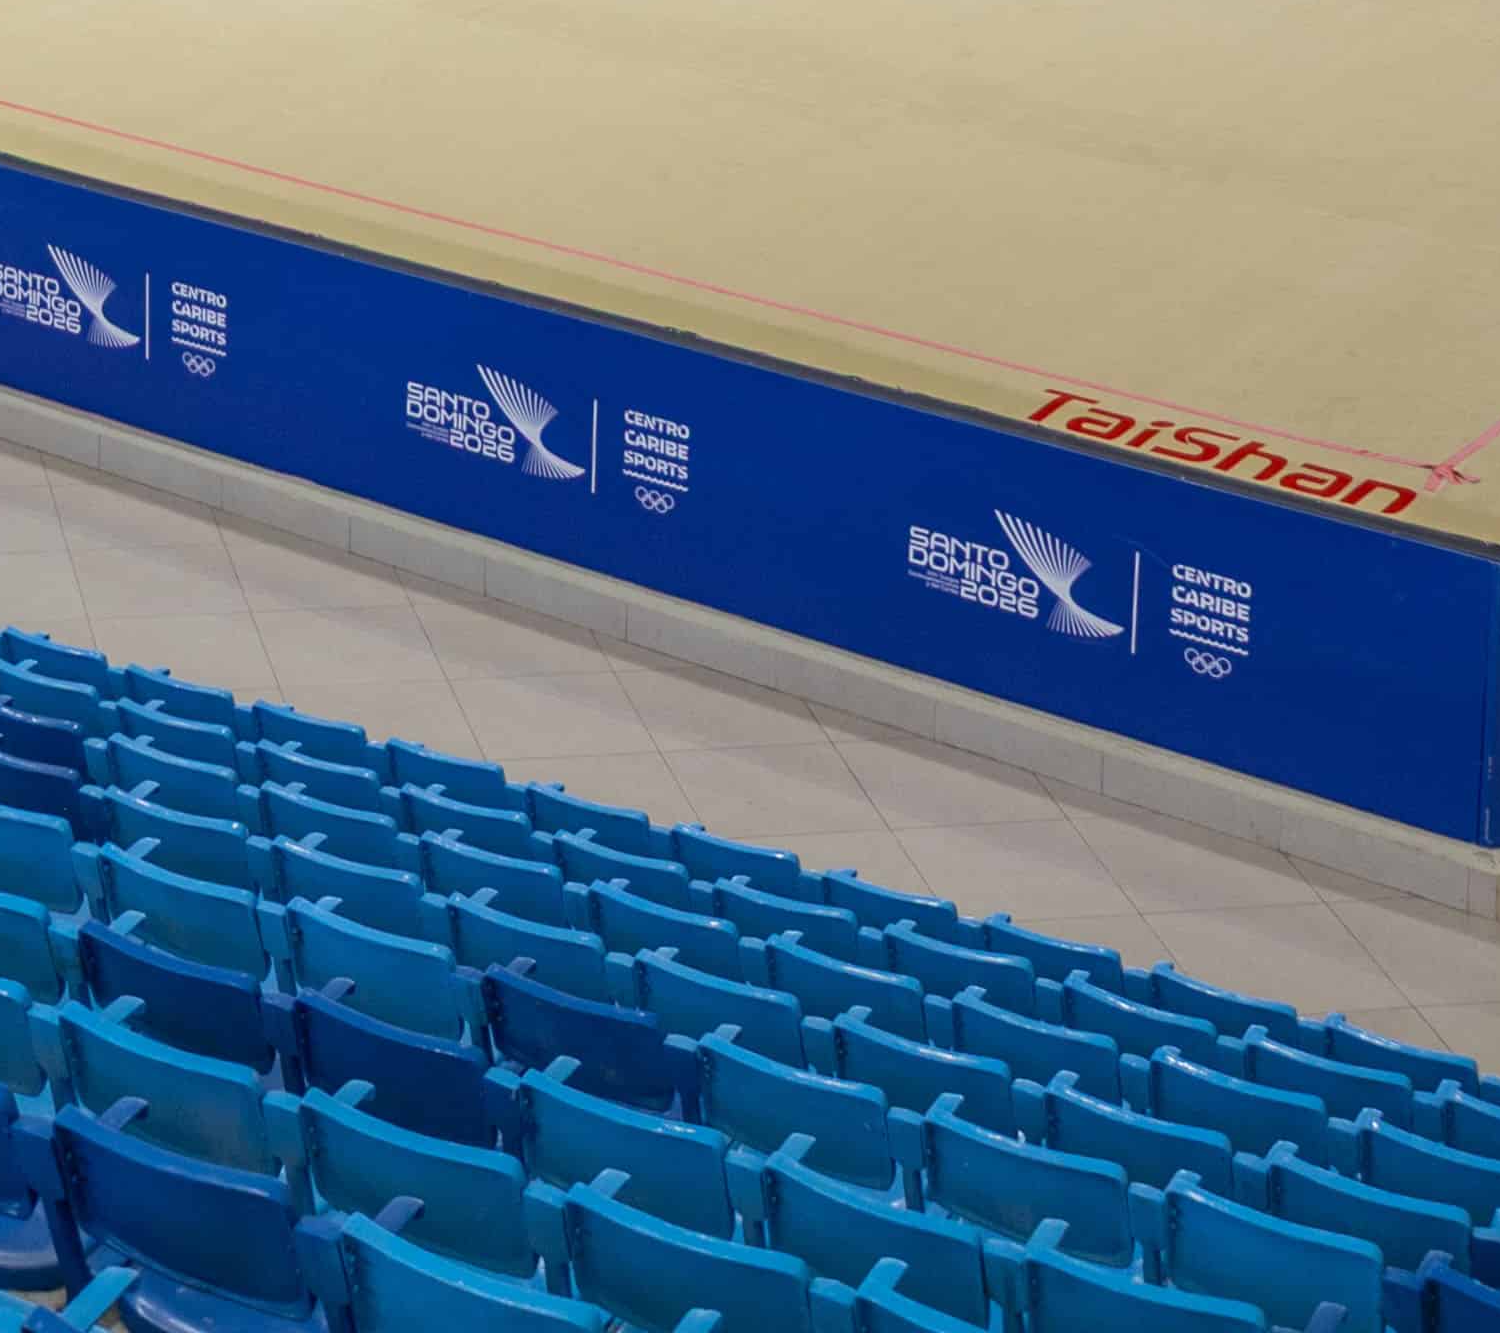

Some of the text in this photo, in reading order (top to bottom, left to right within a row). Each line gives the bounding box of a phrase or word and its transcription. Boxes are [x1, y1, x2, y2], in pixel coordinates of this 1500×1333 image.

[171, 281, 227, 309] CENTRO
[24, 305, 82, 335] 2026
[171, 300, 226, 328] CARIBE
[171, 319, 227, 346] SPORTS
[407, 381, 490, 420] SANTO
[406, 399, 515, 445] DOMINGO
[623, 408, 690, 440] CENTRO
[450, 430, 515, 463] 2026
[623, 429, 689, 461] CARIBE
[1028, 388, 1417, 515] TaiShan
[623, 450, 689, 480] SPORTS
[908, 525, 1010, 570] SANTO
[908, 546, 1040, 600] DOMINGO
[1172, 563, 1252, 599] CENTRO
[959, 581, 1039, 620] 2026
[1171, 585, 1250, 622] CARIBE
[1170, 607, 1249, 643] SPORTS
